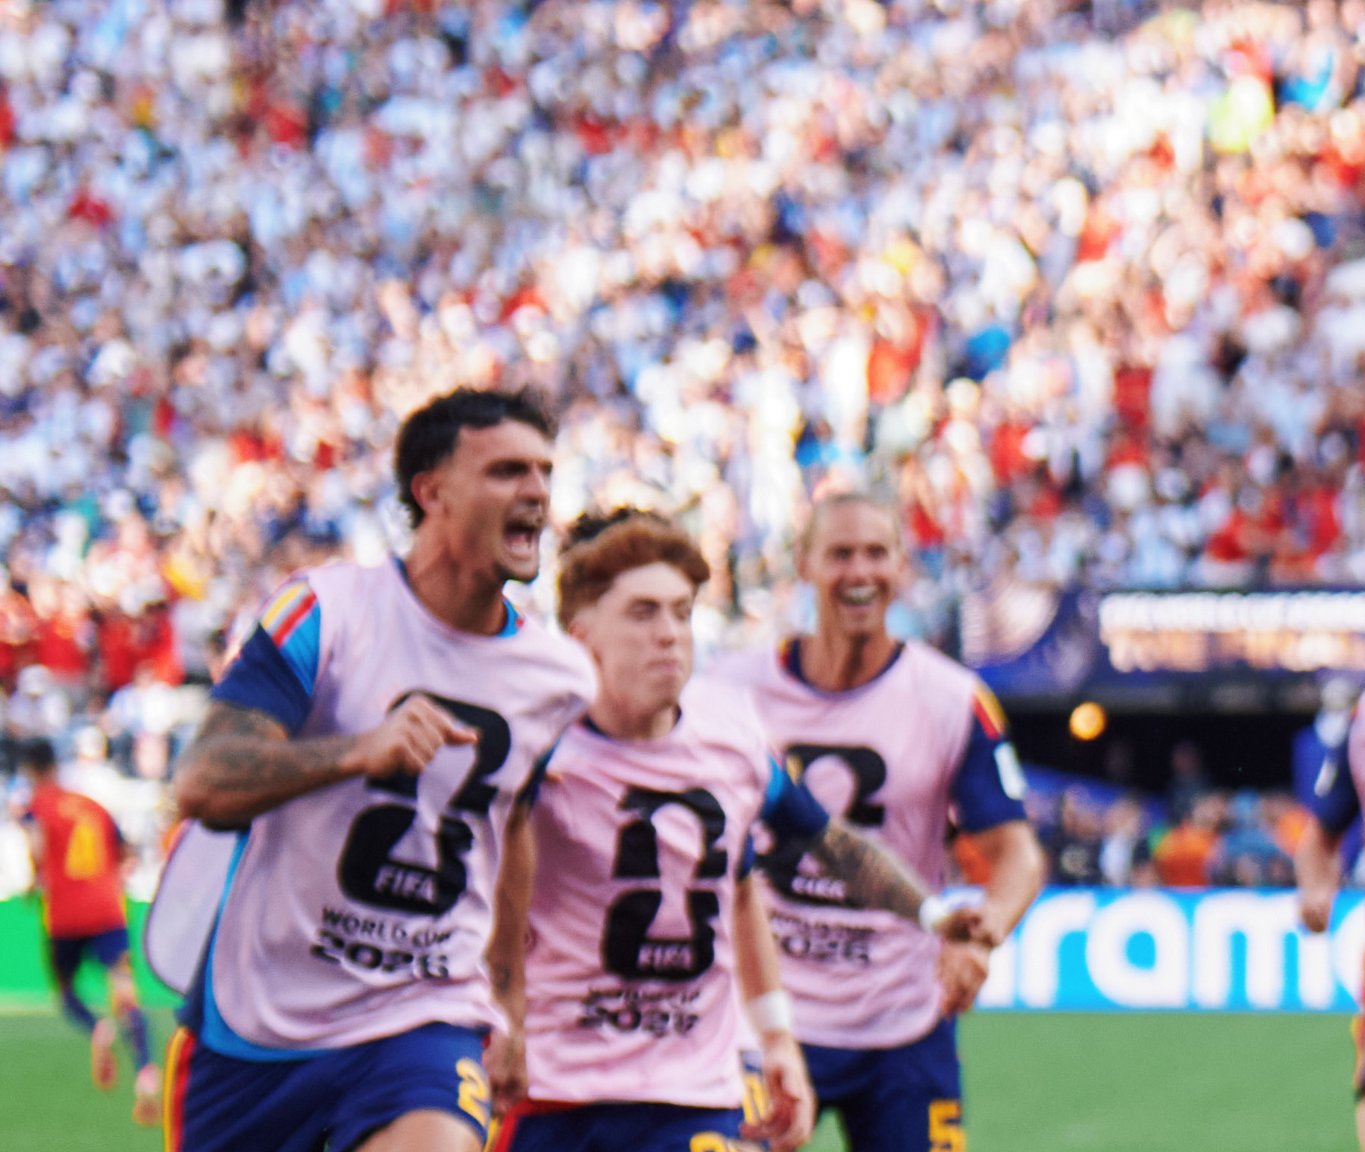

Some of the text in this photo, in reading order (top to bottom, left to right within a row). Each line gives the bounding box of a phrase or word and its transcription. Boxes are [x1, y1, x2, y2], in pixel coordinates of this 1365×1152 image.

[373, 863, 436, 902] FIFA
[322, 907, 407, 944] WORLD
[310, 928, 450, 979] 2026
[773, 930, 871, 968] 026
